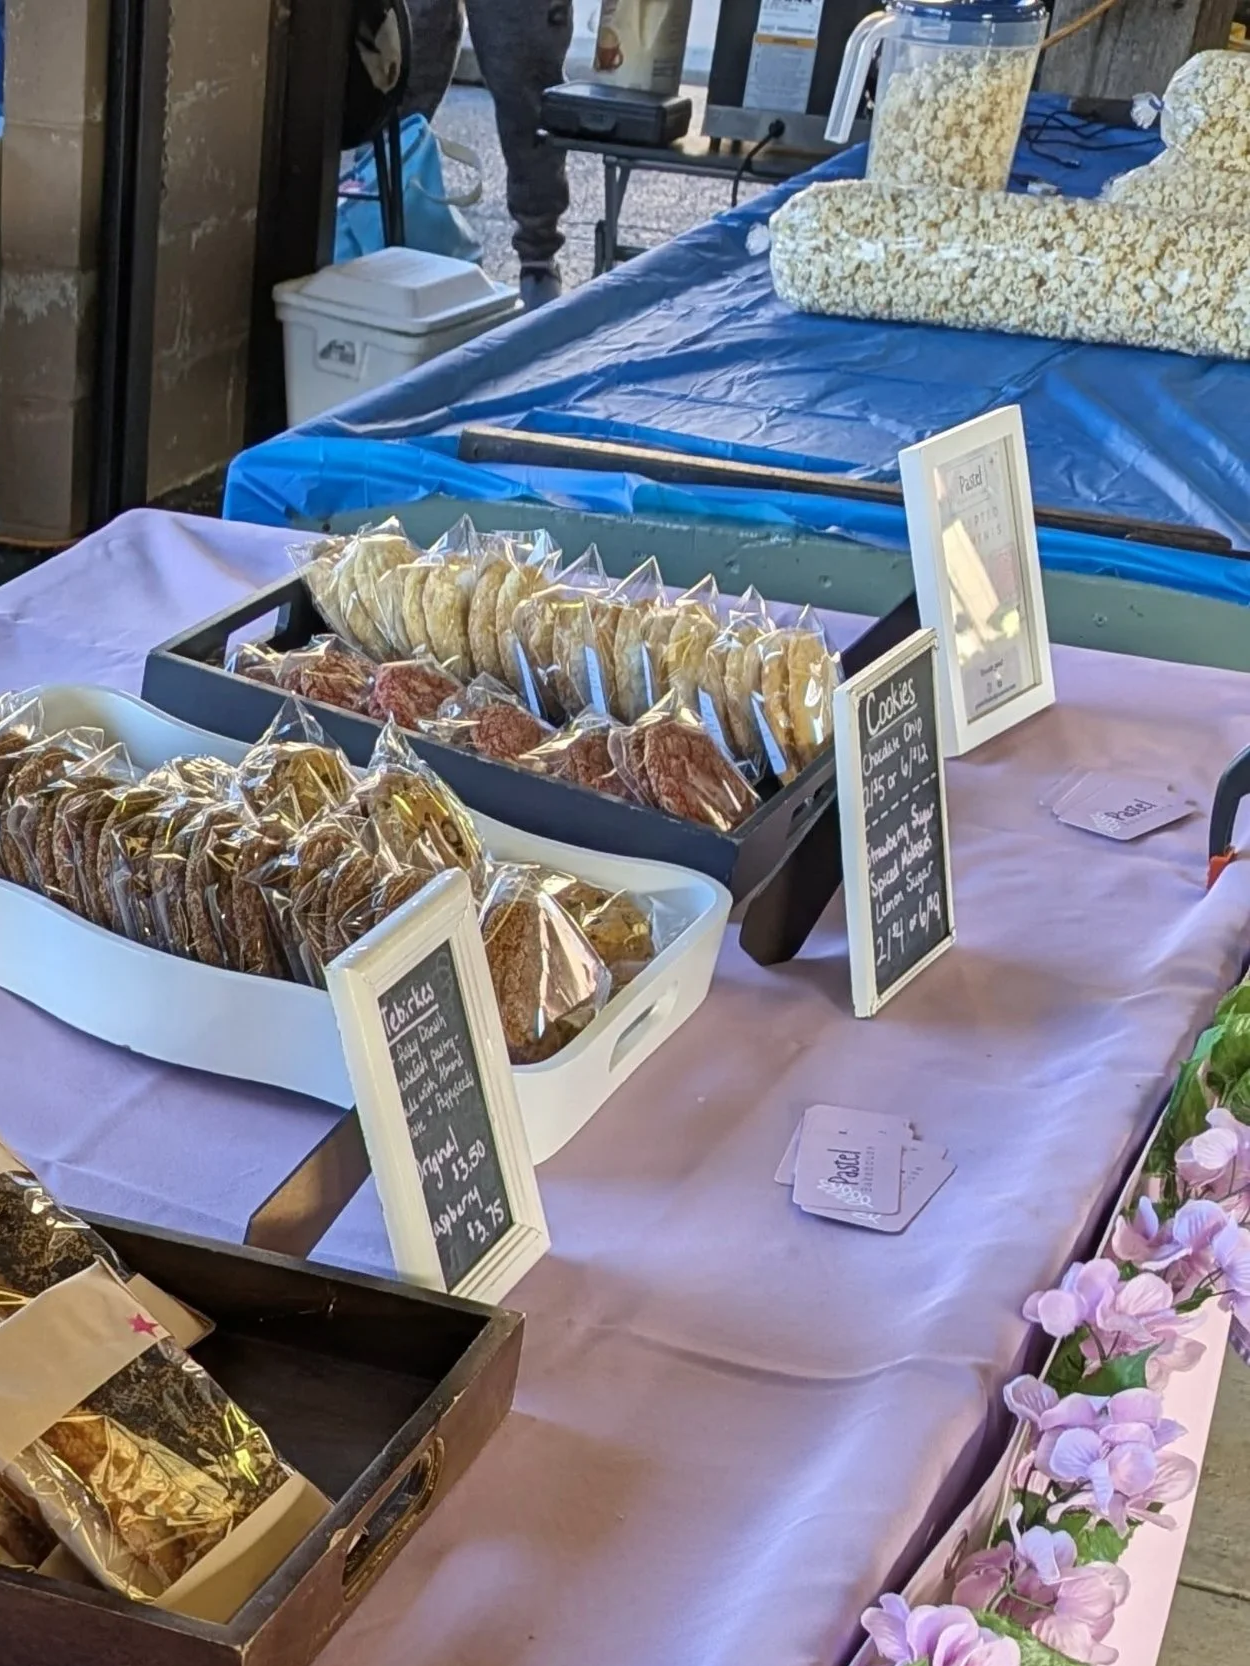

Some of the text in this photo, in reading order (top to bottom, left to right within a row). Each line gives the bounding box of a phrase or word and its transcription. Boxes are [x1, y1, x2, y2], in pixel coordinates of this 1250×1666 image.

[958, 464, 983, 495] Pastel
[866, 678, 916, 736] Cookies
[870, 859, 899, 902] Spiced
[906, 860, 934, 894] Sugar
[380, 981, 435, 1037] Tebirkes
[451, 1139, 486, 1182] $3.50
[826, 1148, 862, 1185] Pastel
[433, 1185, 483, 1237] aspberry
